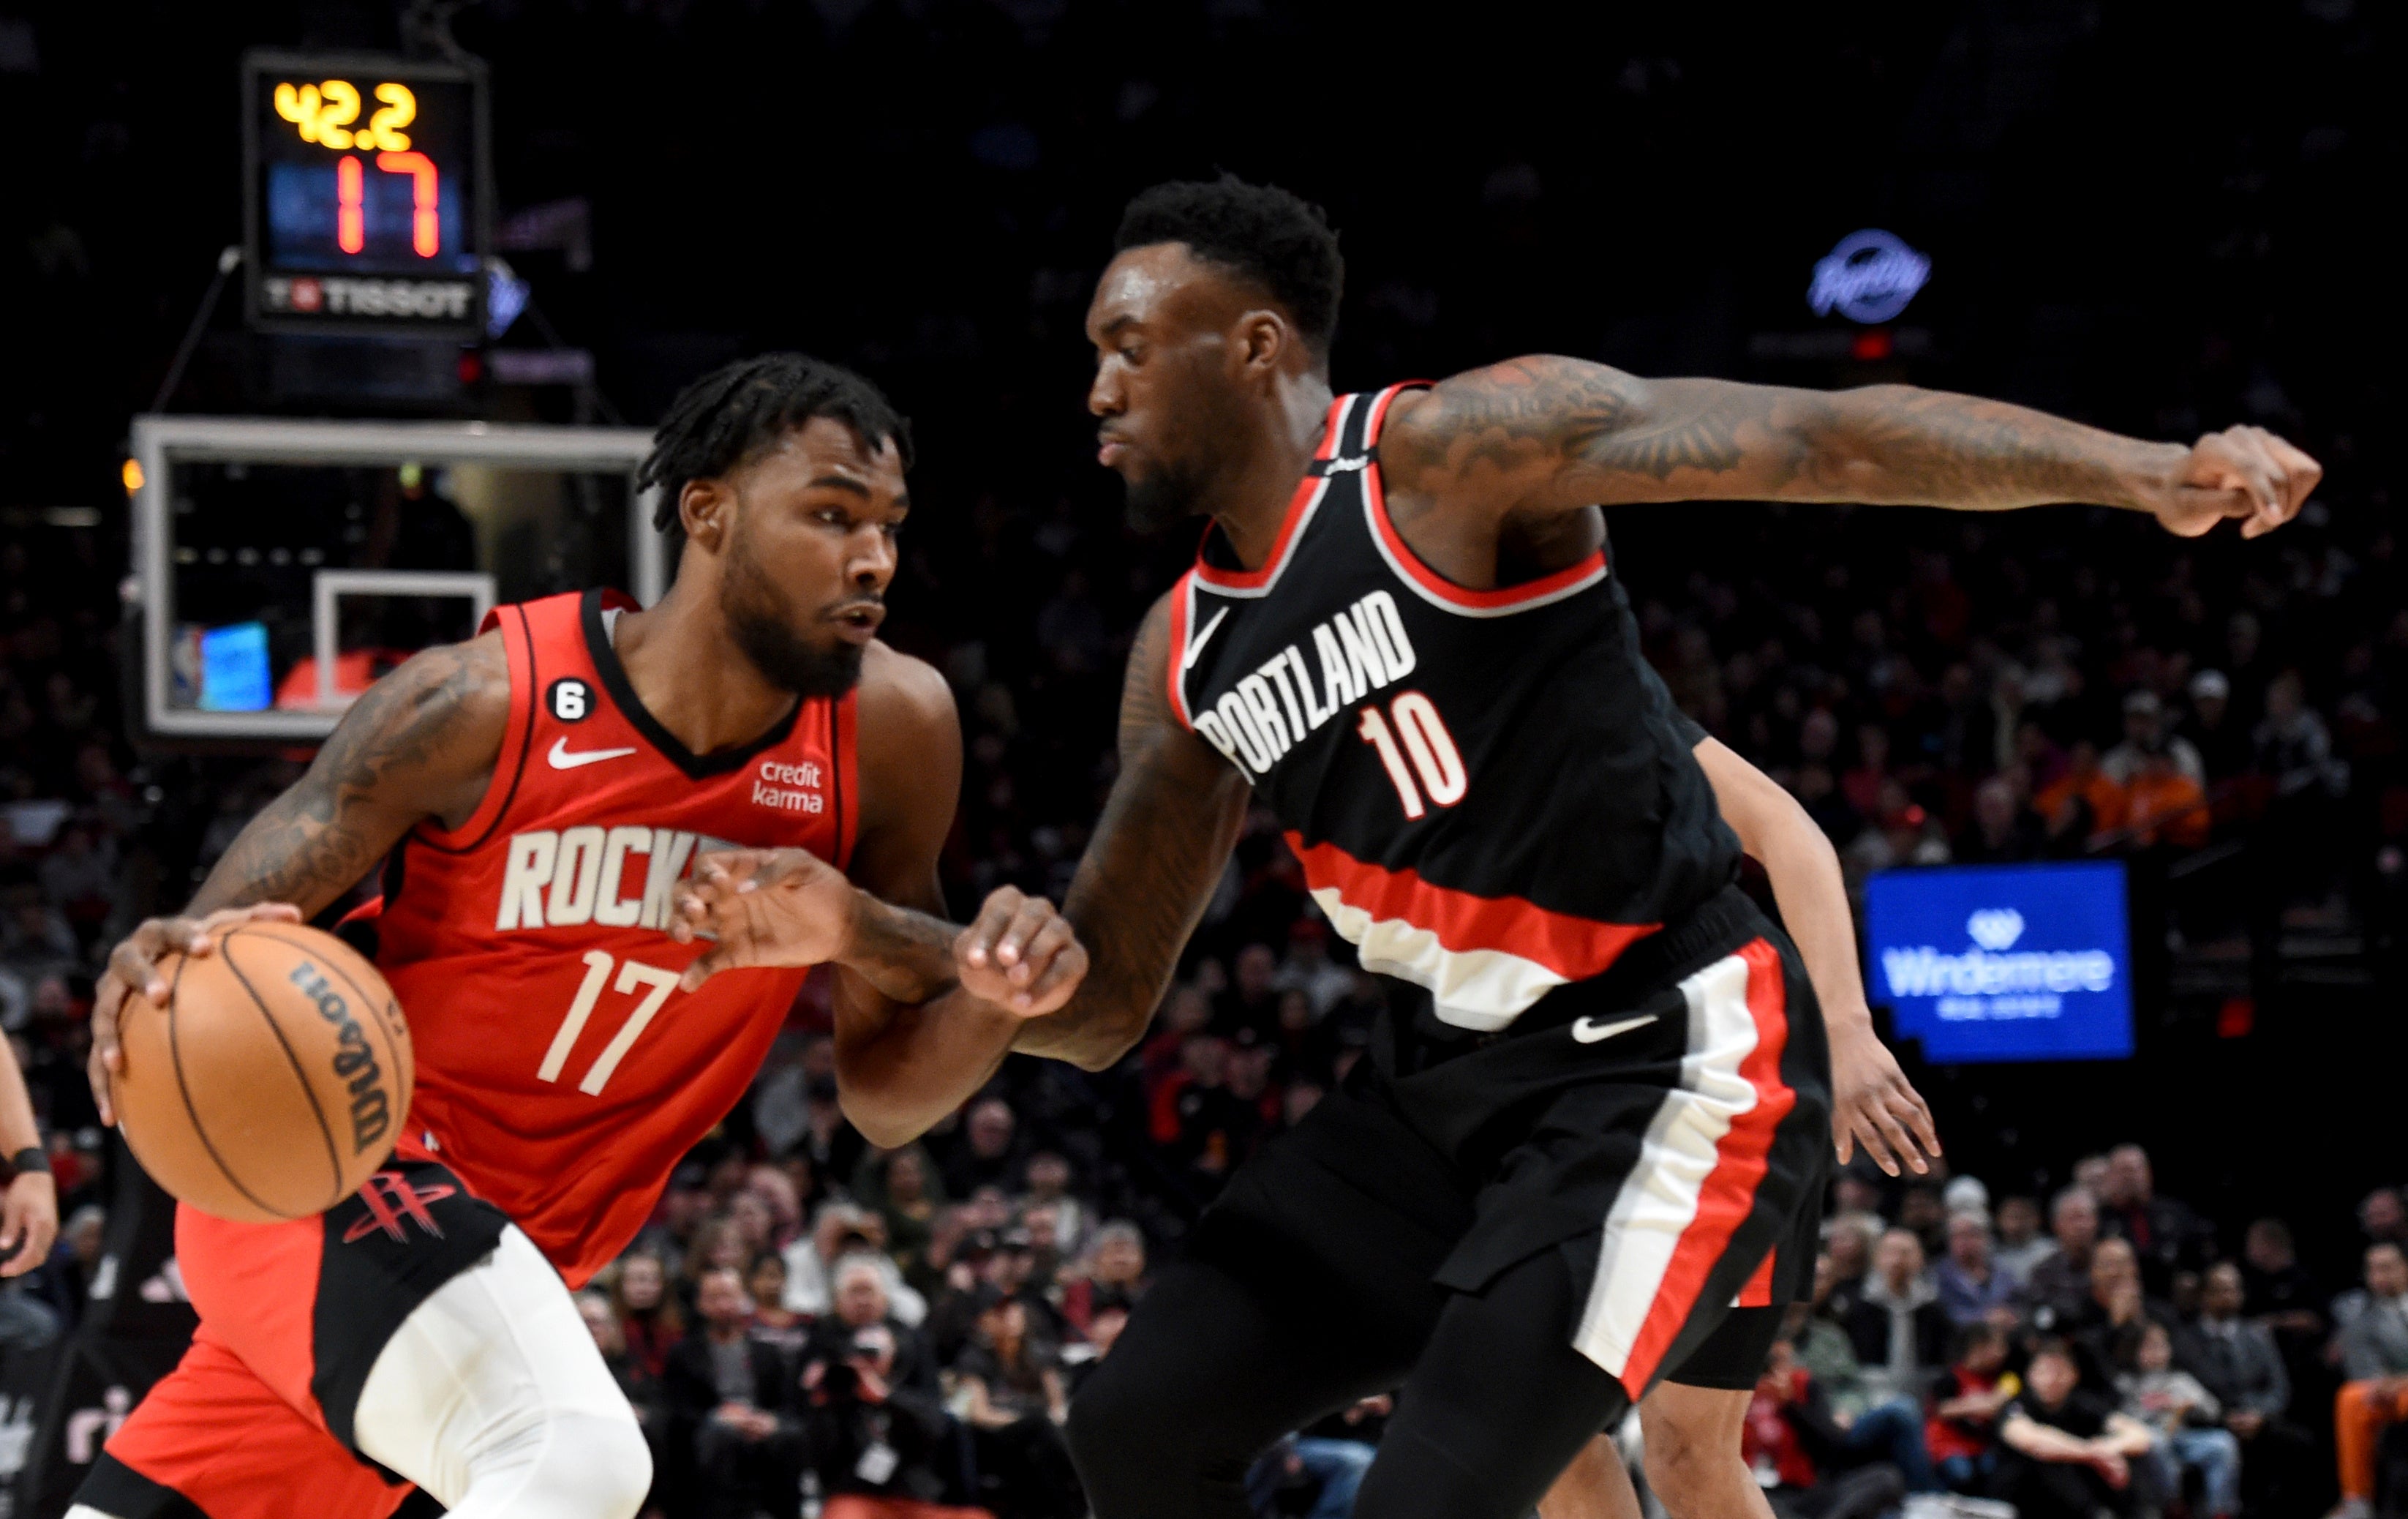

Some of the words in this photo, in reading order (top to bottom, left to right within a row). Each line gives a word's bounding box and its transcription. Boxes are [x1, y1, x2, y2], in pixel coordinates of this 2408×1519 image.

[274, 80, 416, 151] 42.2
[337, 151, 439, 258] 17
[324, 277, 472, 319] TISSOT
[555, 681, 586, 719] 6
[1192, 590, 1417, 786] PORTLAND
[752, 781, 824, 814] karma
[761, 760, 821, 789] credit
[1357, 689, 1469, 822] 10
[496, 825, 745, 932] ROCK
[289, 961, 389, 1155] Wilson
[537, 949, 683, 1097] 17
